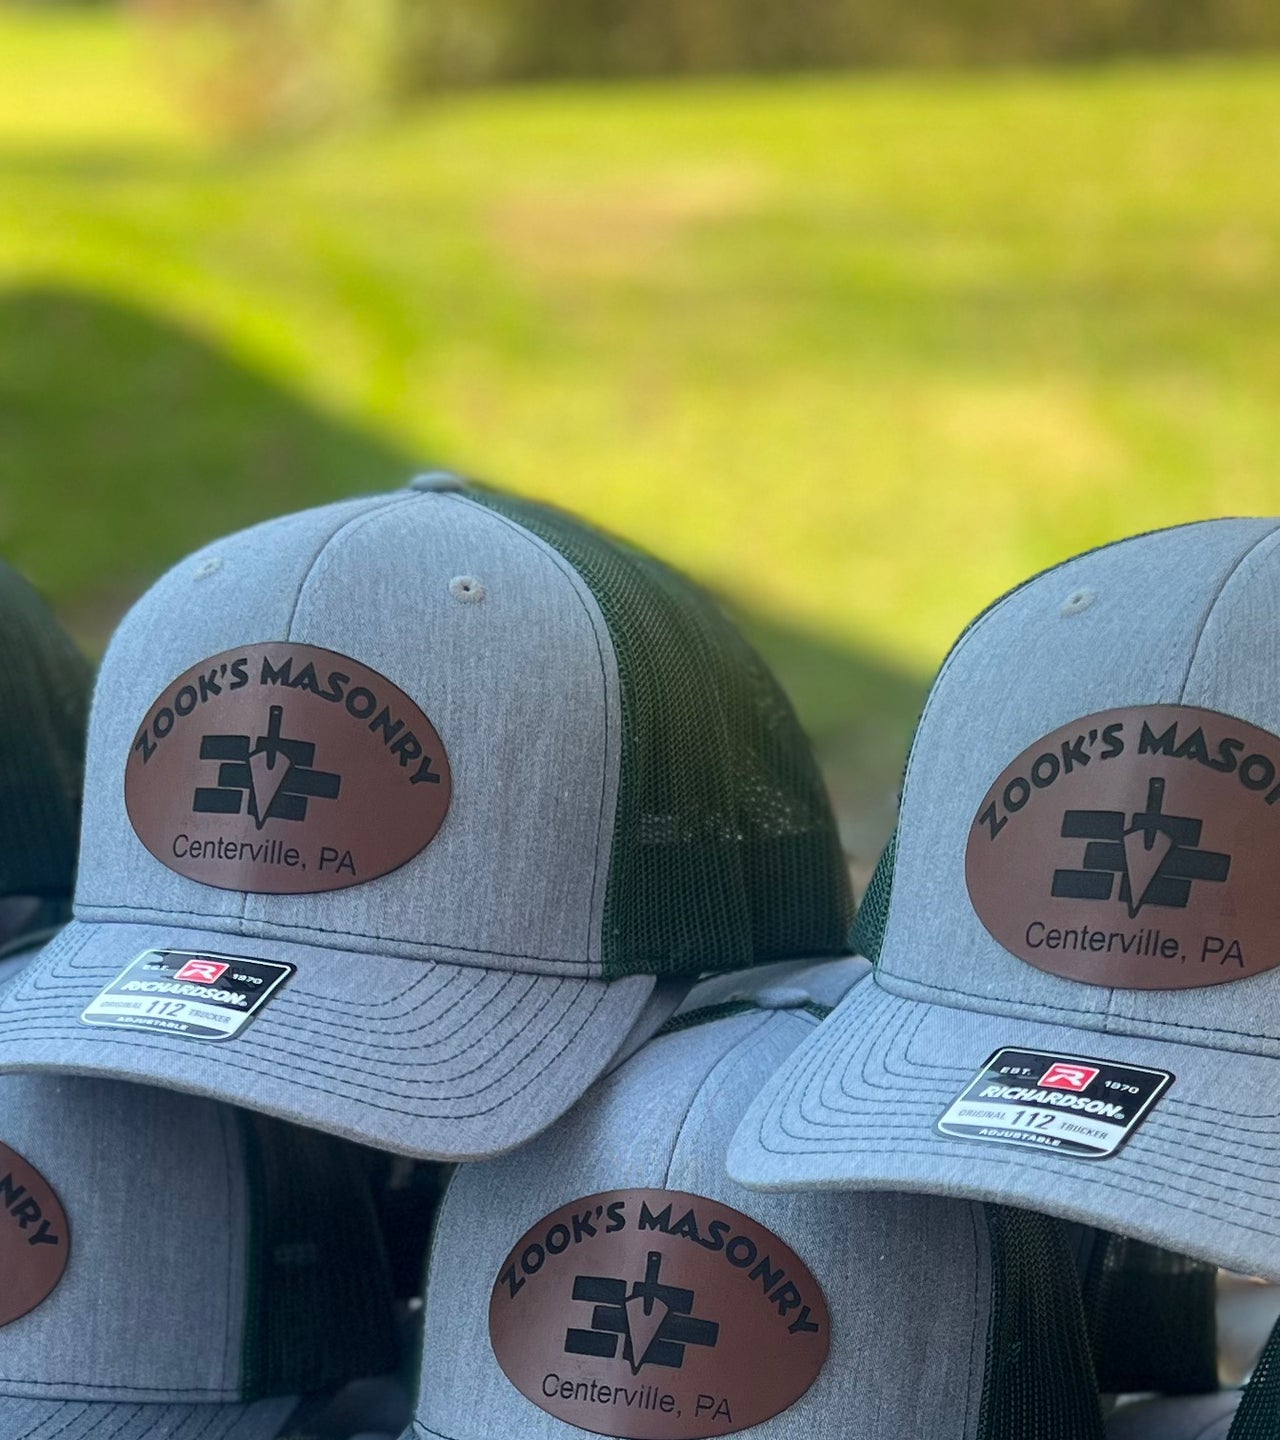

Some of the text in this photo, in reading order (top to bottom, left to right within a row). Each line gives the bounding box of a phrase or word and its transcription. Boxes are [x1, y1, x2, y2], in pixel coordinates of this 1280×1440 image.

[135, 656, 440, 785] ZOOK'S MASONRY
[980, 723, 1125, 840] ZOOK'S
[172, 834, 356, 875] Centerville, PA
[1025, 921, 1246, 968] Centerville, PA
[146, 1000, 186, 1017] 112
[1011, 1110, 1056, 1130] 112
[1060, 1122, 1108, 1139] TRUCKER
[501, 1200, 819, 1335] ZOOK'S MASONRY
[542, 1374, 733, 1423] Centerville, PA
